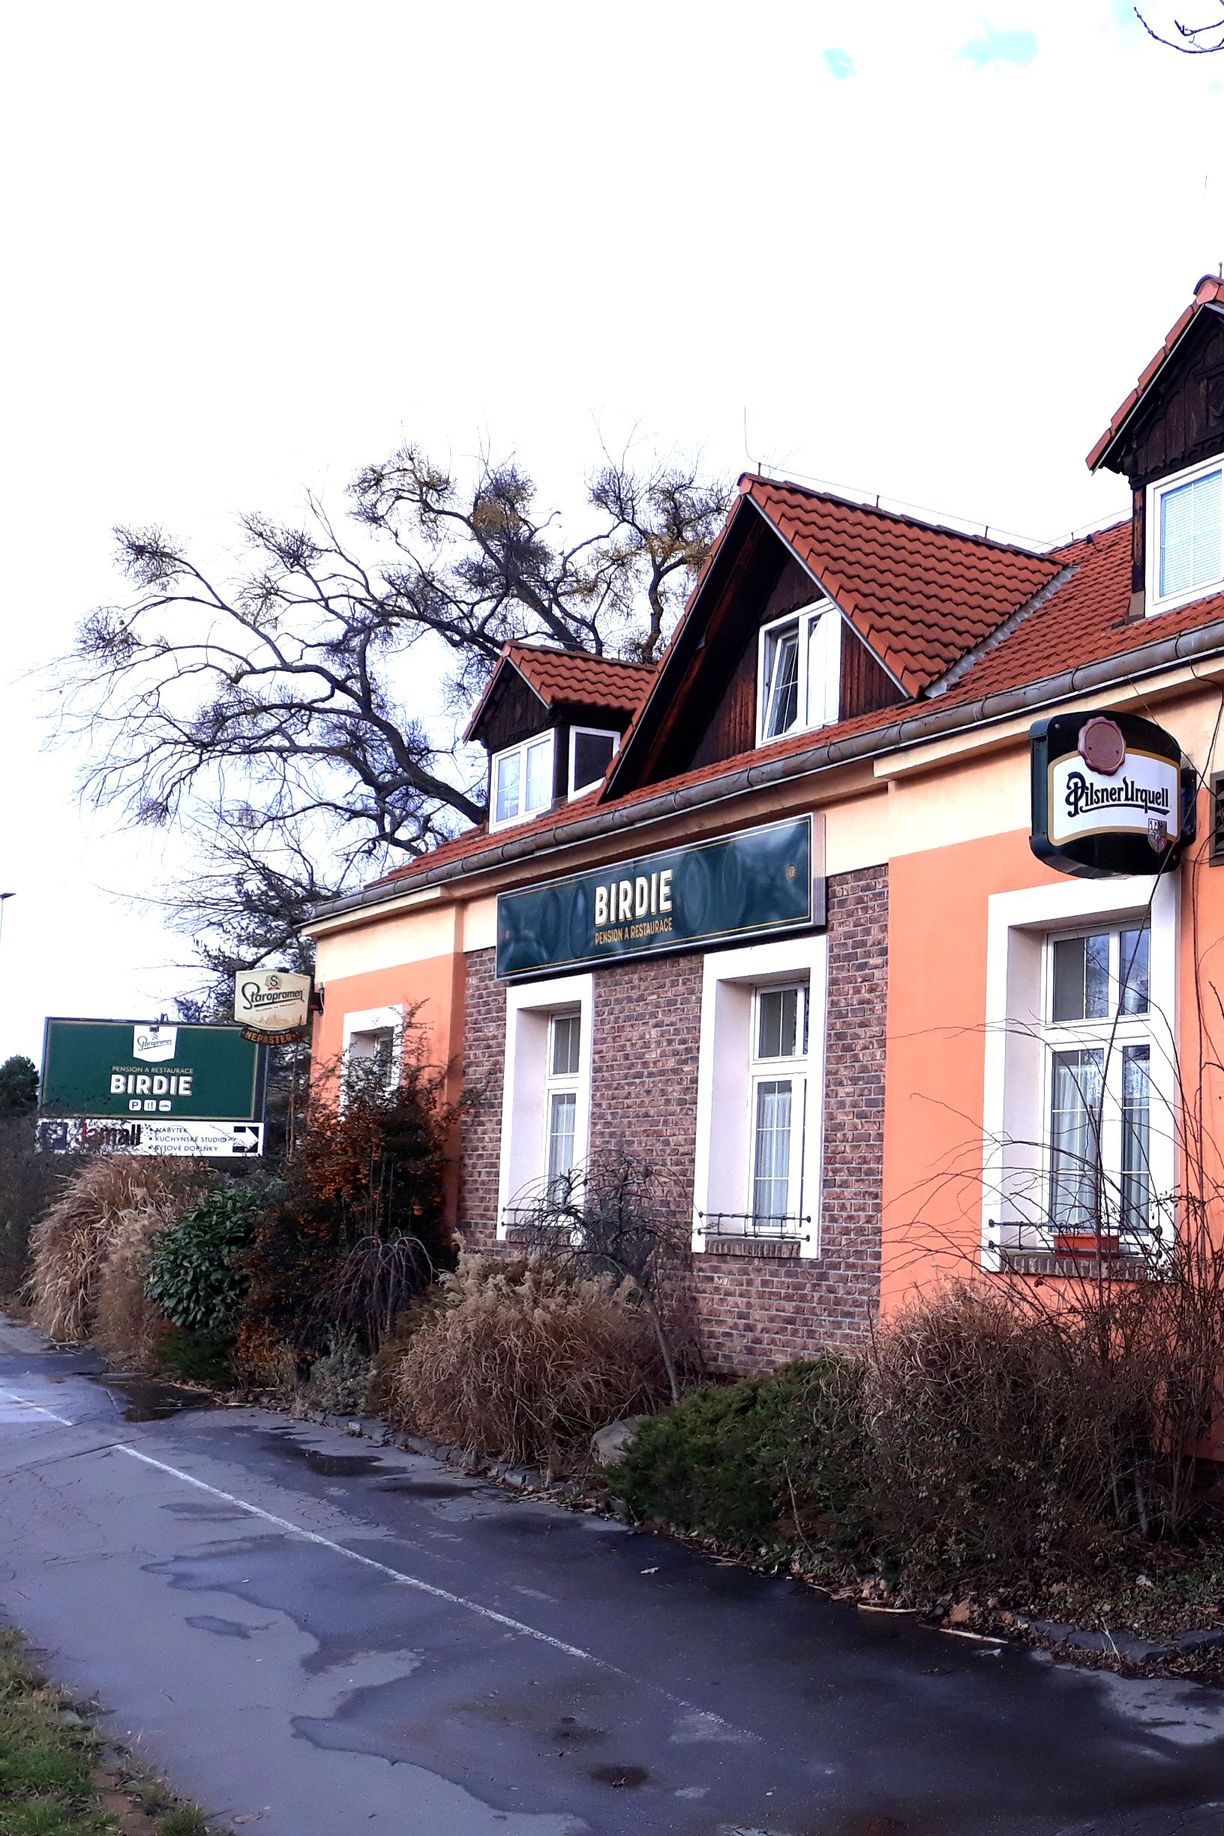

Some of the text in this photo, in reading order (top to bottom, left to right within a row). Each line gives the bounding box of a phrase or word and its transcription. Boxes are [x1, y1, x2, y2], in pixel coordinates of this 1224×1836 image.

[1064, 771, 1169, 818] Pilsner Urquell
[594, 868, 673, 928] BIRDIE
[594, 916, 673, 946] PENSION A RESTAURACE
[241, 981, 305, 1010] Staropramen
[112, 1065, 143, 1073] PENSION
[150, 1066, 194, 1074] RESTAURACE
[110, 1073, 193, 1097] BIRDIE
[200, 1136, 227, 1144] STUDIO
